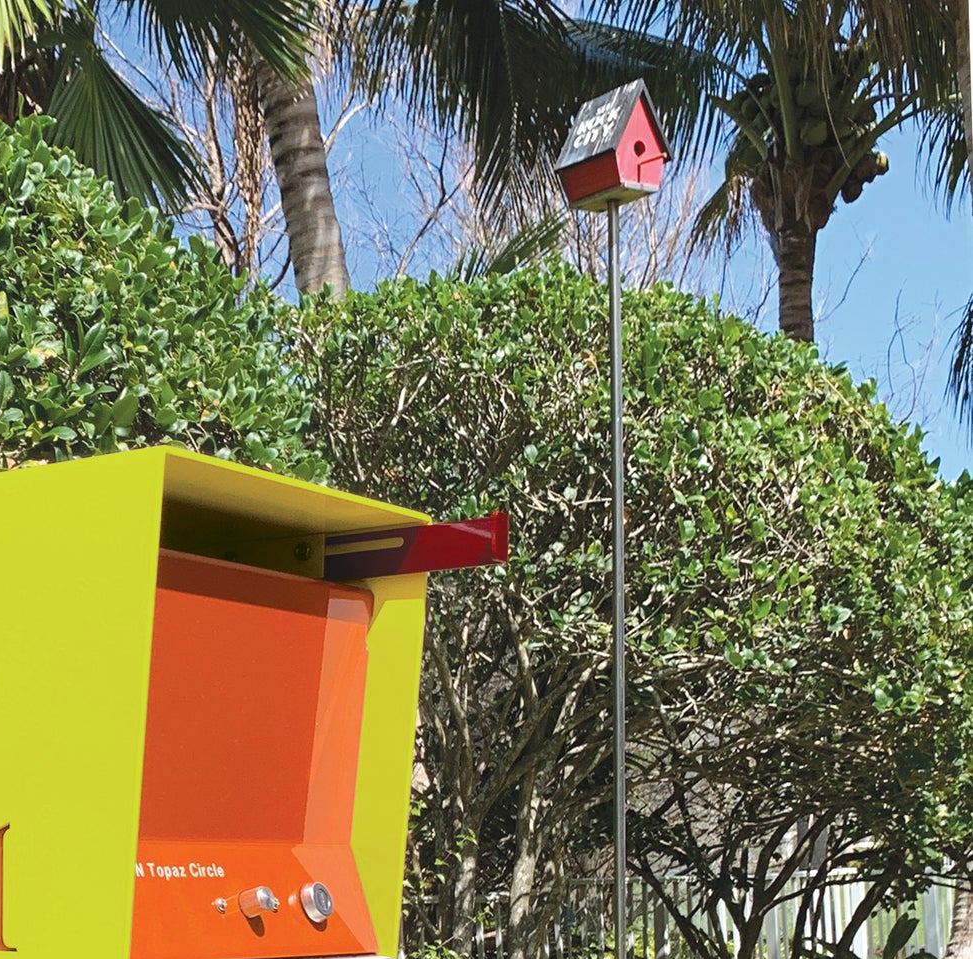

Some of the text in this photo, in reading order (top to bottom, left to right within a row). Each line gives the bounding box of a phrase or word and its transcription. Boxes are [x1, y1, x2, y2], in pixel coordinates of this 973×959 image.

[573, 121, 614, 148] CITY
[135, 862, 225, 880] N Topaz Circle
